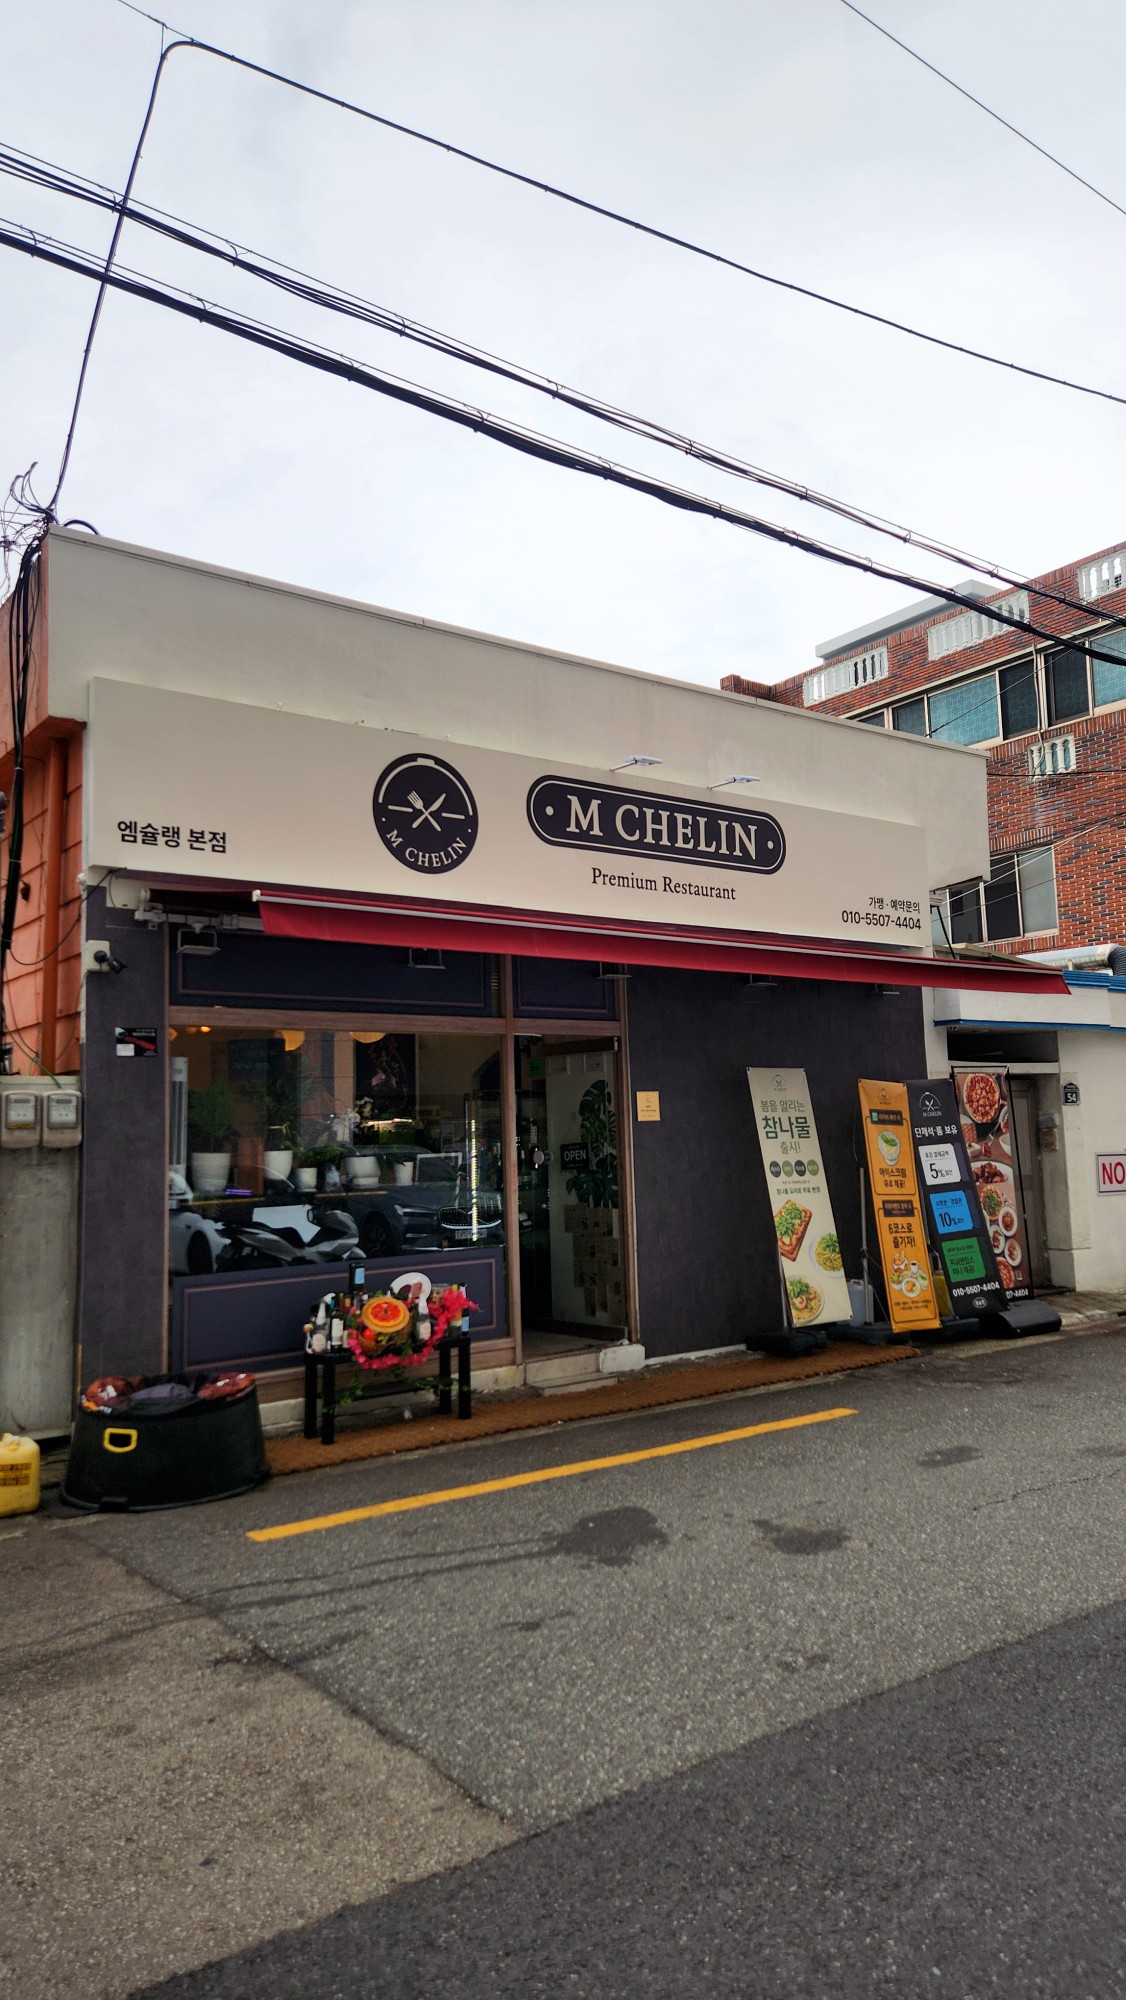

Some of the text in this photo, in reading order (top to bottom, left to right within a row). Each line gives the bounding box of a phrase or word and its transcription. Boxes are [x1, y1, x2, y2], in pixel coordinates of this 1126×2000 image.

[566, 794, 757, 860] M CHELIN
[117, 820, 227, 854] 엠슐랭 본점
[386, 828, 468, 868] M CHELIN
[591, 867, 737, 901] Premium Restaurant
[868, 896, 921, 914] 가맹 예약문의
[841, 910, 922, 931] 010-5507-4404
[760, 1100, 806, 1113] 봄을 알리는
[1067, 1093, 1077, 1103] 54
[762, 1115, 811, 1139] 참나물
[944, 1124, 958, 1135] 보유
[563, 1149, 587, 1162] OPEN
[780, 1141, 802, 1155] 출시!
[1102, 1161, 1126, 1185] NO
[888, 1222, 914, 1235] 6코스로
[892, 1236, 916, 1249] 즐기자!
[952, 1281, 1000, 1298] 010-5507-4404
